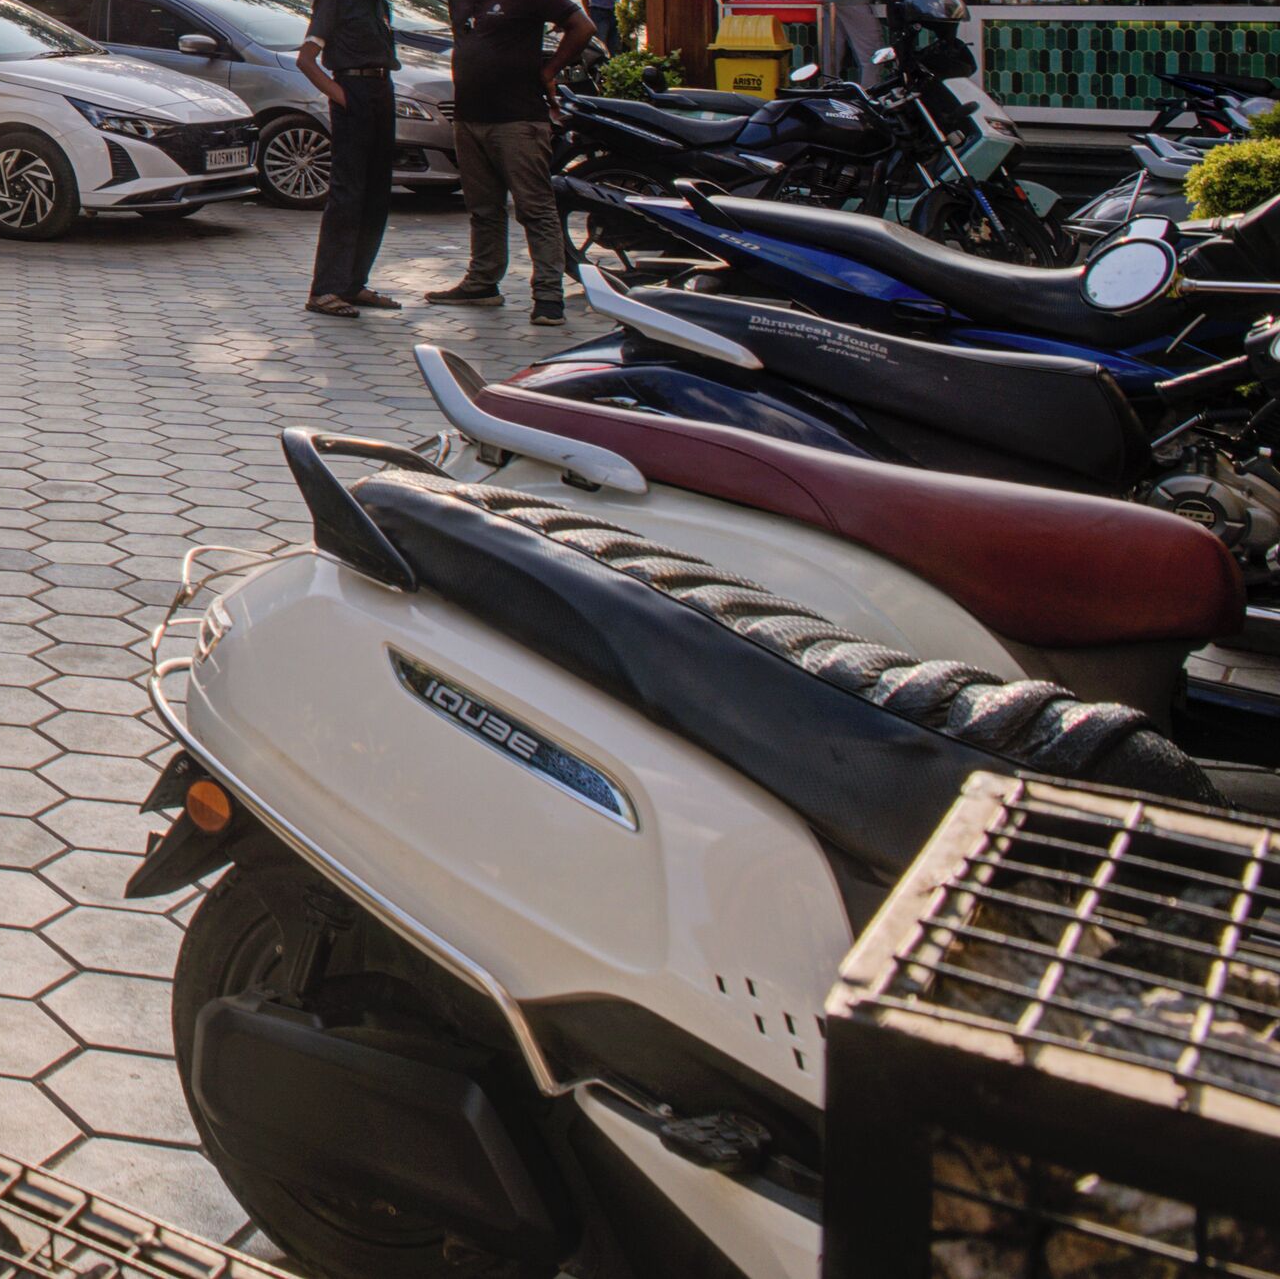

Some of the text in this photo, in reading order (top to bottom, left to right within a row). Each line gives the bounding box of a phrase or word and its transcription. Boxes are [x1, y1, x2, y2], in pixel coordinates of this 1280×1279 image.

[733, 77, 762, 86] ARISTO
[749, 314, 889, 355] Dhruvdesh Honda
